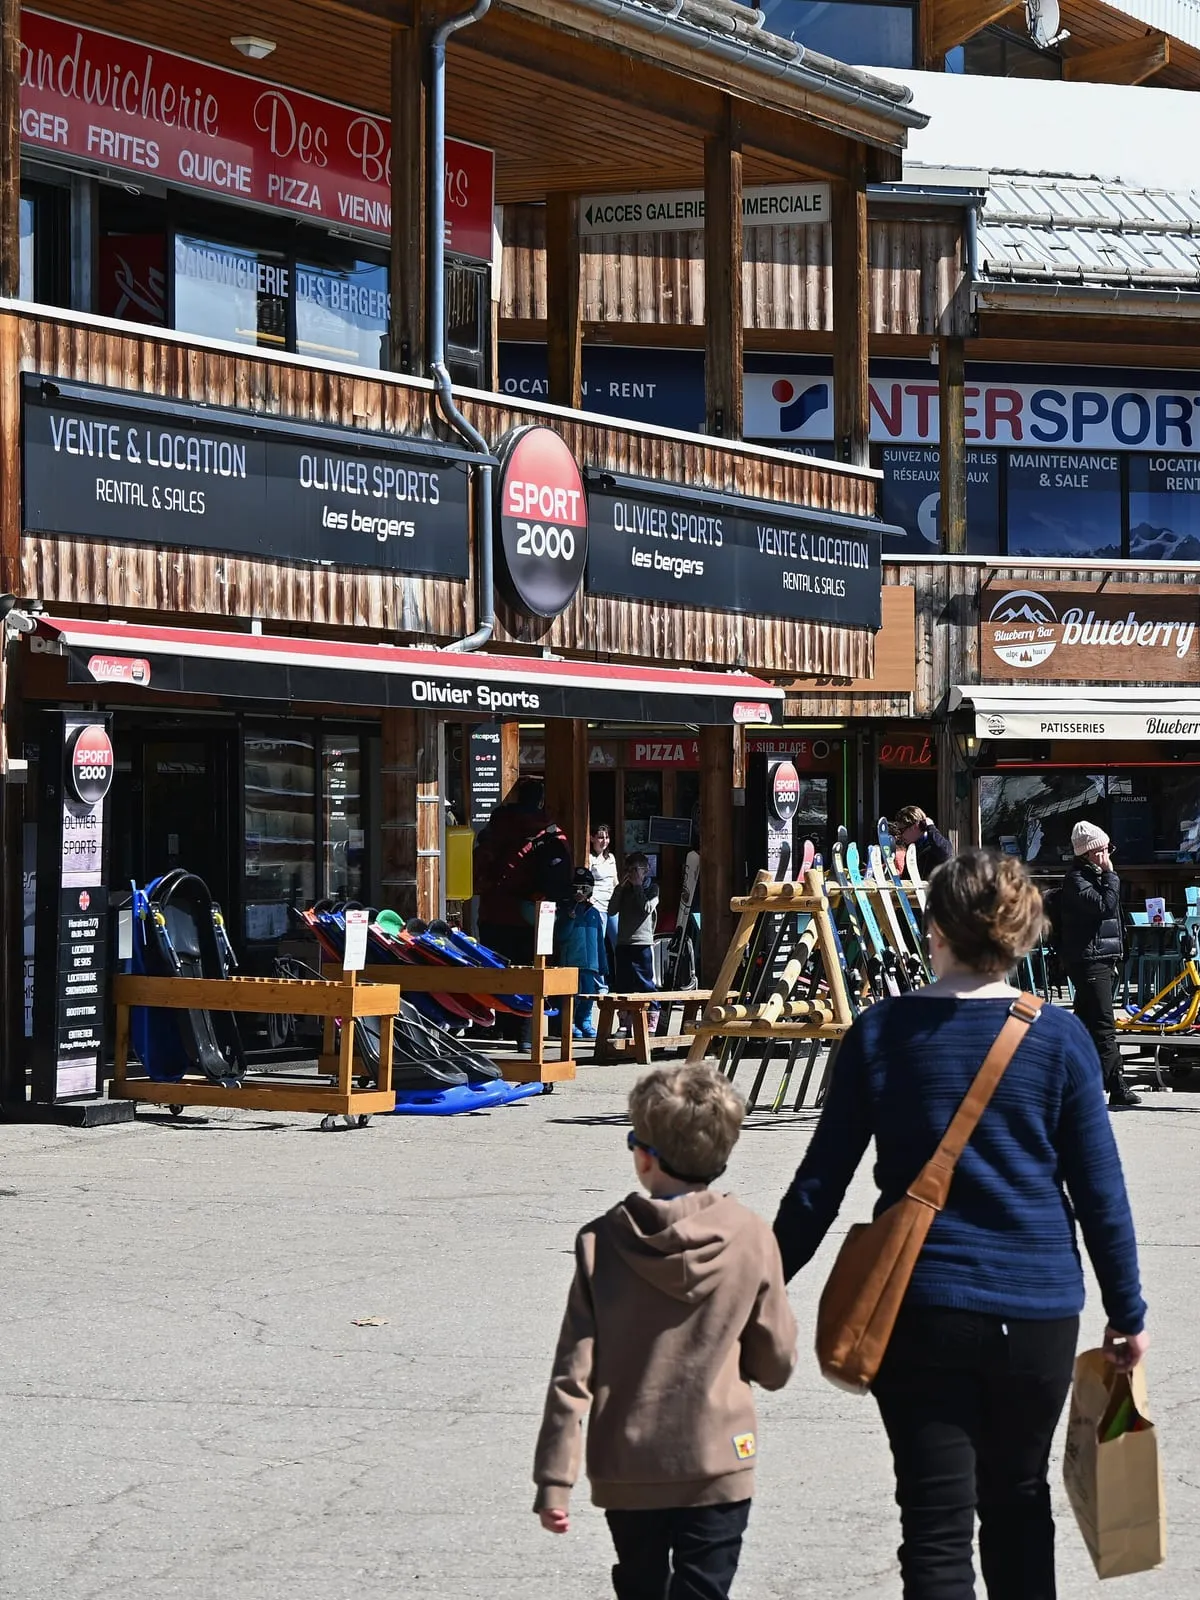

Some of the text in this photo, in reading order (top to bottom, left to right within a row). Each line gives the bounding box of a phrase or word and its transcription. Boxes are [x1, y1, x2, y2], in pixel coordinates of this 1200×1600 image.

[19, 32, 219, 138] andwicherie
[253, 90, 328, 168] Des
[87, 124, 160, 169] FRITES
[178, 149, 252, 194] QUICHE
[267, 173, 322, 211] PIZZA
[595, 203, 642, 224] ACCES
[646, 199, 705, 221] GALERIE
[298, 272, 326, 306] DES
[609, 382, 657, 398] RENT
[50, 415, 247, 479] VENTE & LOCATION
[883, 450, 921, 462] SUIVEZ
[980, 453, 998, 465] LES
[1009, 454, 1118, 471] MAINTENANCE
[300, 454, 440, 505] OLIVIER SPORTS
[892, 467, 939, 481] RÉSEAUX
[1039, 473, 1089, 488] & SALE
[96, 477, 206, 515] RENTAL & SALES
[508, 480, 581, 522] SPORT
[322, 505, 416, 542] les bergers
[614, 502, 724, 547] OLIVIER SPORTS
[516, 521, 575, 561] 2000
[756, 525, 869, 569] VENTE & LOCATION
[631, 546, 704, 579] les bergers
[782, 571, 845, 597] RENTAL & SALES
[993, 626, 1055, 642] Blueberry Bar
[1061, 607, 1196, 659] Blueberry
[91, 659, 128, 676] Olivier
[411, 680, 540, 711] Olivier Sports
[1040, 722, 1105, 734] PATISSERIES
[77, 750, 110, 764] SPORT
[635, 743, 685, 761] PIZZA
[755, 741, 775, 753] SUR
[779, 741, 807, 753] PLACE
[79, 766, 107, 780] 2000
[776, 779, 798, 791] SPORT
[777, 792, 796, 803] 2000
[64, 815, 97, 830] OLIVIER
[63, 840, 97, 855] SPORTS
